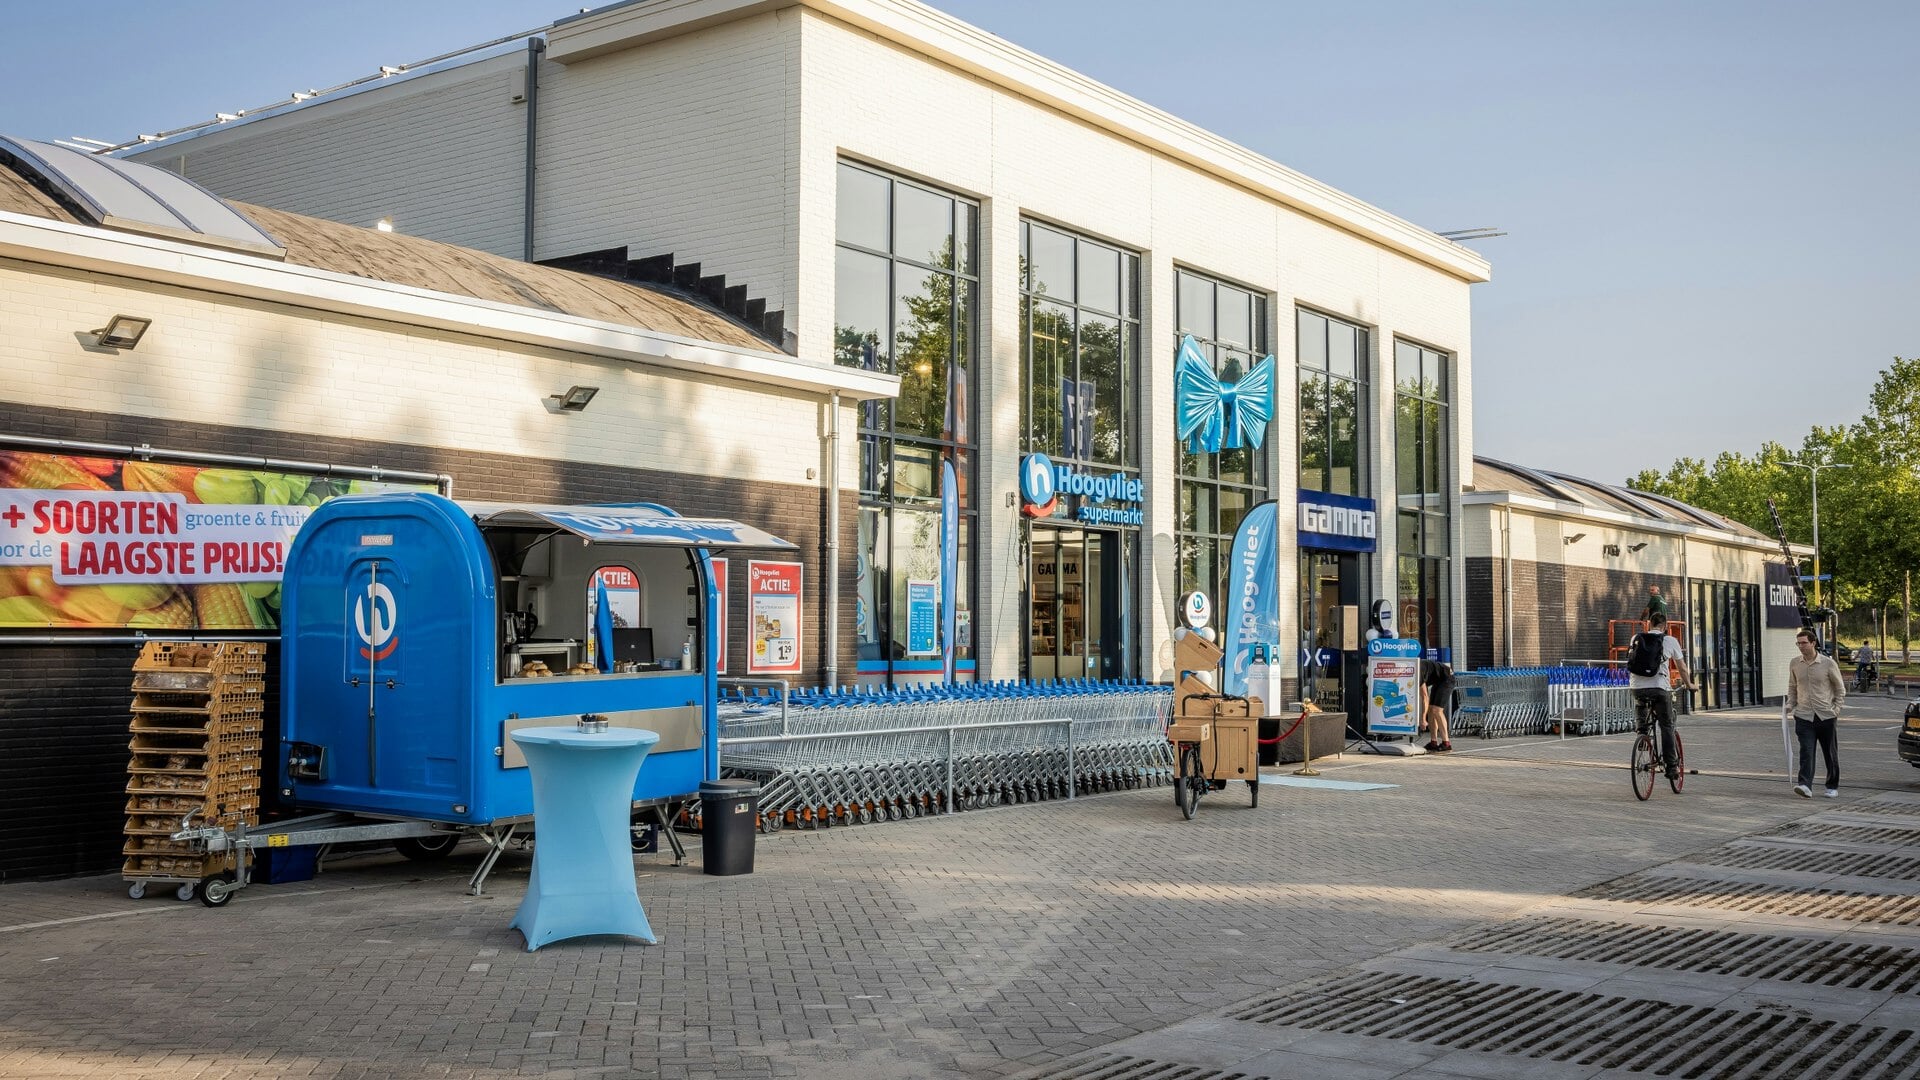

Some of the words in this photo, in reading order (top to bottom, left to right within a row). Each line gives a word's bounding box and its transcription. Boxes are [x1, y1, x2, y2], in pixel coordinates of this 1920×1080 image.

[1058, 465, 1144, 503] Hoogvliet
[32, 499, 178, 535] SOORTEN
[185, 511, 251, 530] groente
[254, 511, 266, 526] &
[270, 510, 307, 527] fruit
[1083, 506, 1144, 525] supermarkt
[1299, 502, 1376, 539] GAMMA
[29, 540, 52, 558] de
[60, 541, 196, 576] LAAGSTE
[203, 541, 284, 575] PRIJS!
[760, 579, 791, 592] ACTIE!
[1240, 525, 1260, 644] Hoogvliet
[1770, 583, 1798, 607] GAMM
[1383, 643, 1418, 651] Hoogvliet
